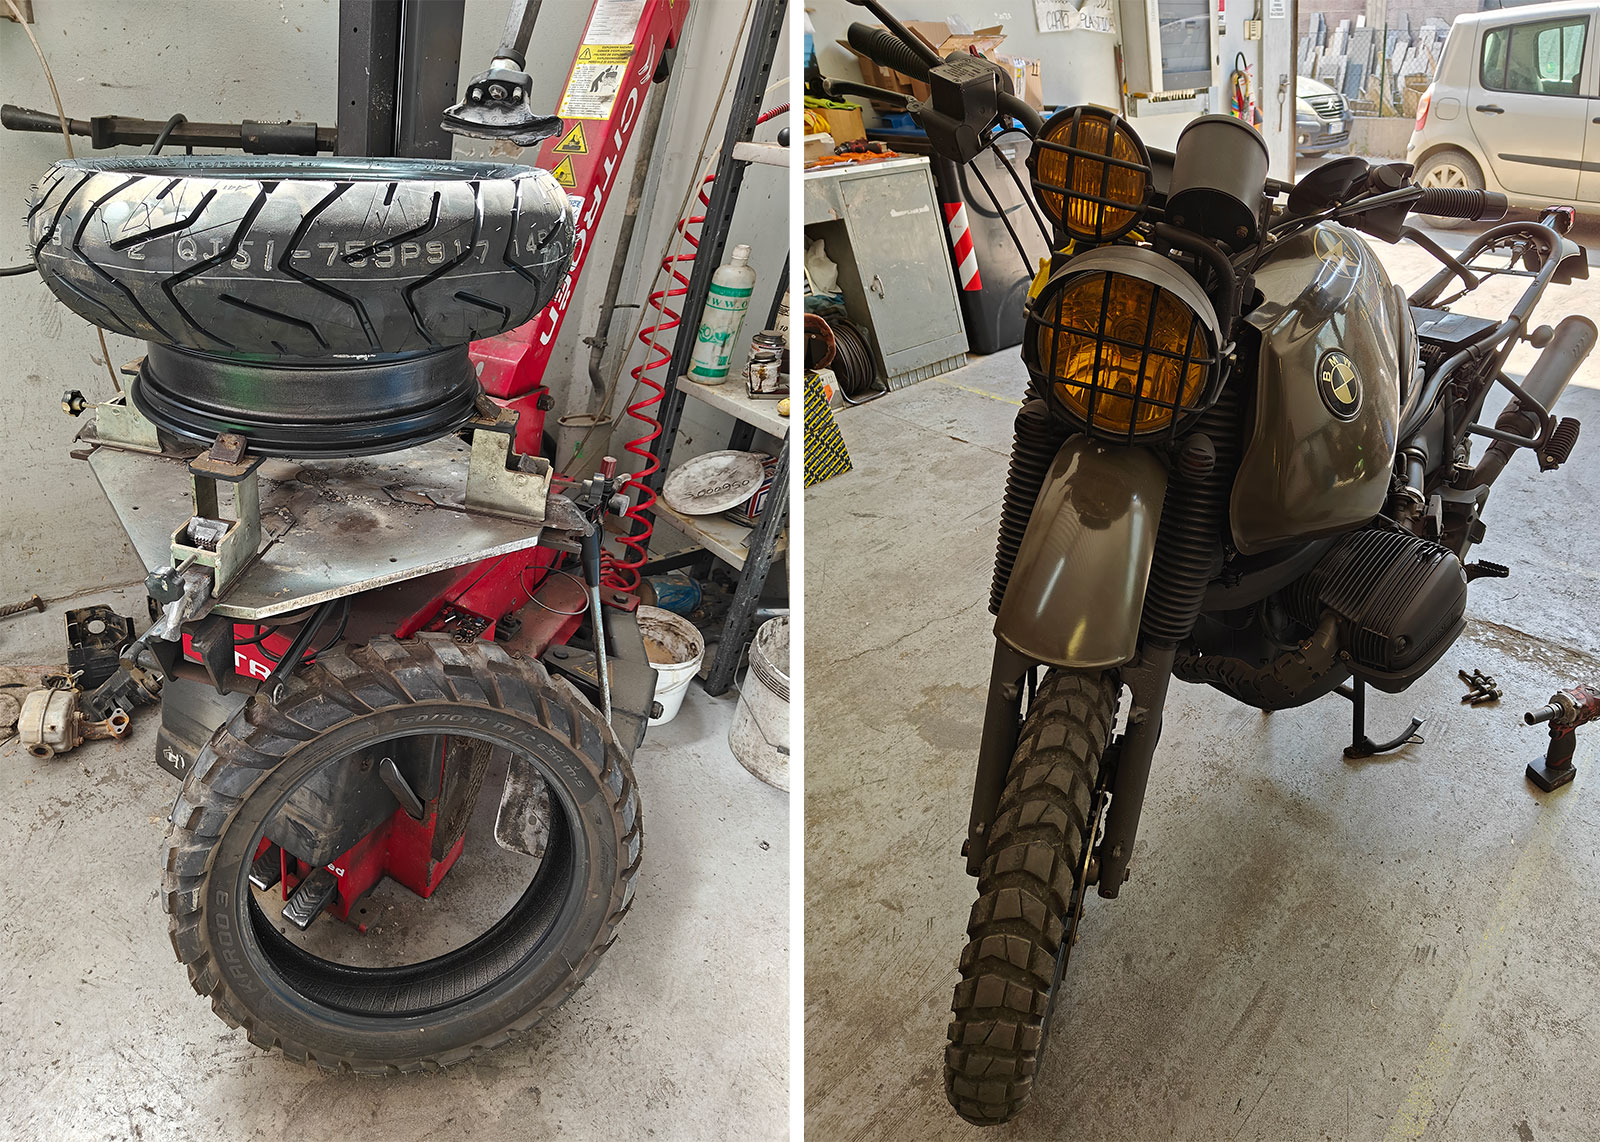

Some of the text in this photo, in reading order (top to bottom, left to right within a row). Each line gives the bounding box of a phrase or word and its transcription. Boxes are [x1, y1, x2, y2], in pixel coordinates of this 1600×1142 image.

[1322, 355, 1352, 382] BMW
[215, 889, 259, 995] KAROO 3
